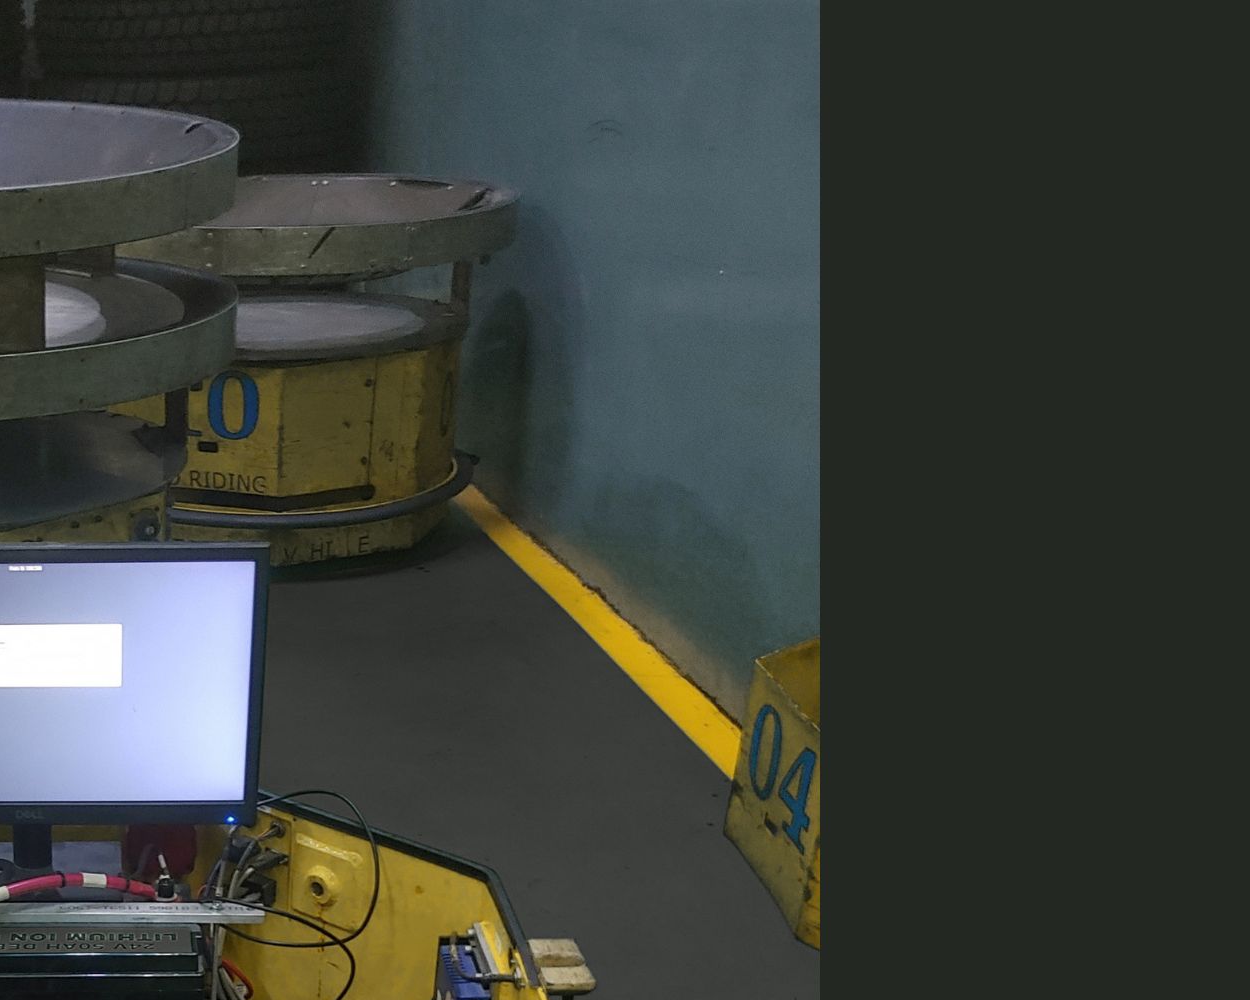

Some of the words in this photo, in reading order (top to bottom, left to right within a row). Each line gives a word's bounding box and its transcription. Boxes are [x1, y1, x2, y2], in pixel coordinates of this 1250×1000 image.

[190, 470, 267, 494] RIDING
[749, 704, 817, 855] 04
[10, 932, 56, 942] ION
[67, 932, 177, 942] LITHIUM
[115, 942, 155, 950] 24V
